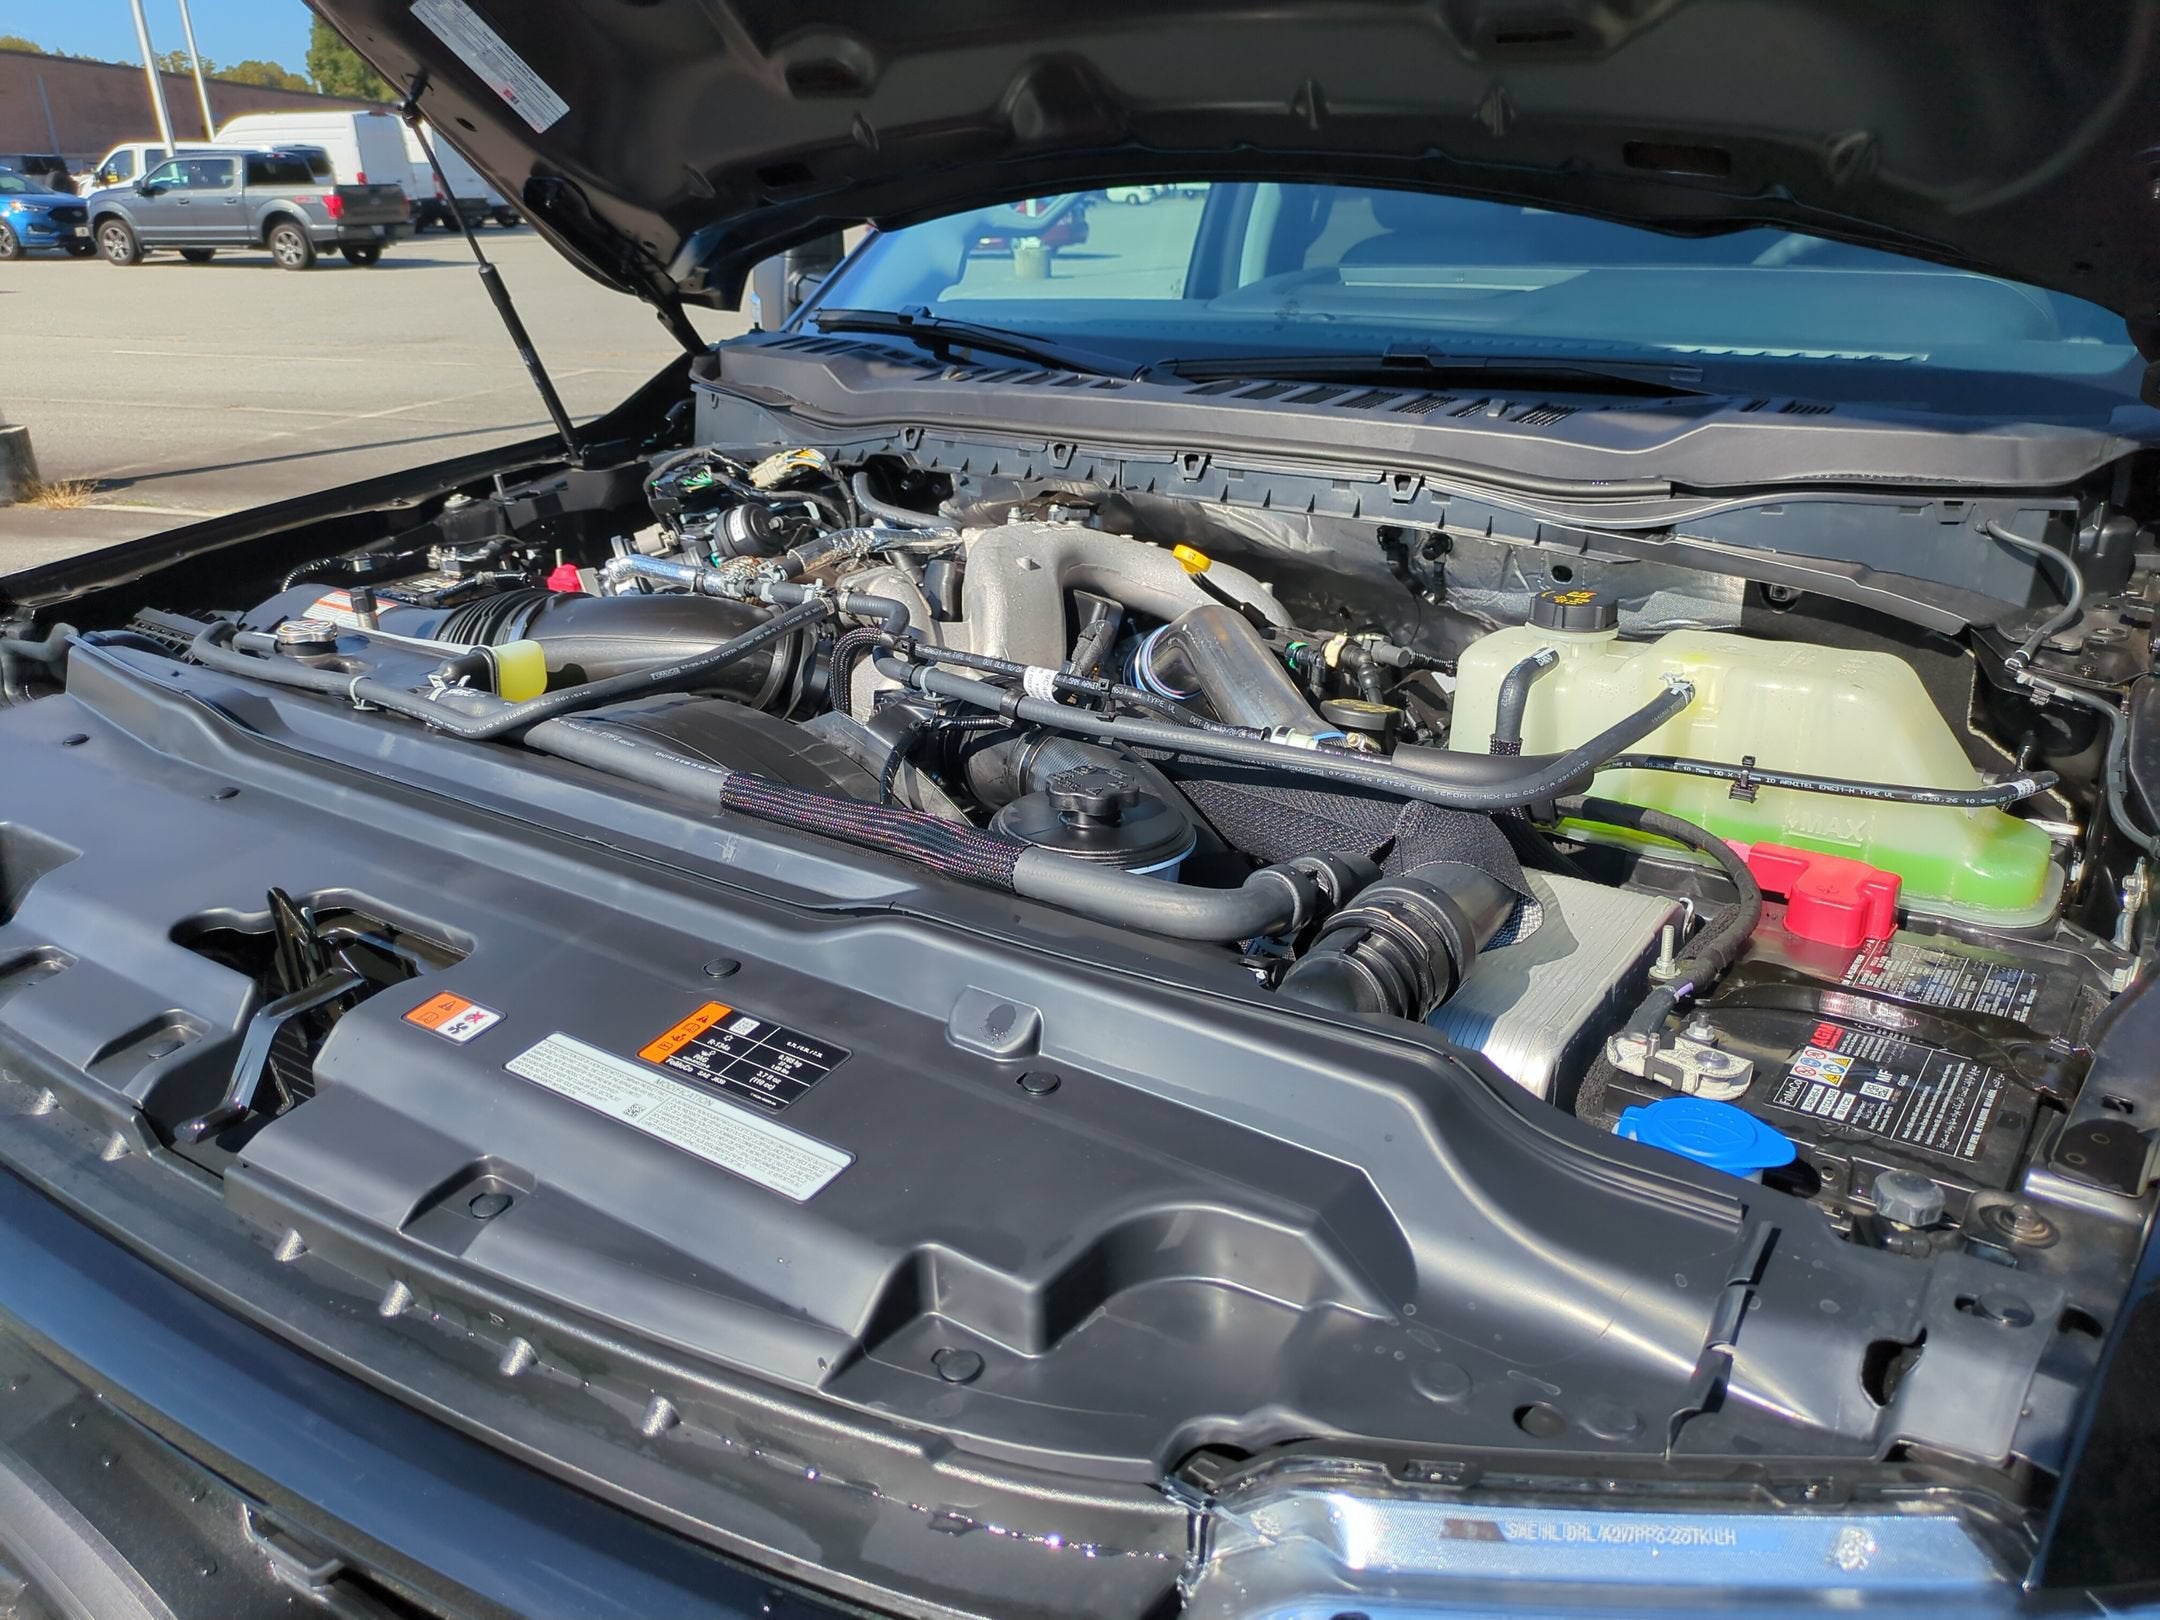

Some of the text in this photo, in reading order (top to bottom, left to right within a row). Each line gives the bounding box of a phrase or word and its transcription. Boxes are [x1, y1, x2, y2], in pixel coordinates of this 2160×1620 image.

[1146, 694, 1165, 709] TYPE
[1779, 779, 1815, 789] ARNITEL
[1859, 788, 1880, 797] TYPE
[1798, 811, 1867, 842] MAX
[707, 1038, 731, 1052] R-134a
[692, 1053, 710, 1063] PAG
[665, 1057, 694, 1073] FoMoCo
[696, 1070, 711, 1080] SAE
[756, 1070, 767, 1078] 3.7
[1875, 1068, 1894, 1083] MF
[653, 1077, 715, 1106] MODIFICATION
[1778, 1079, 1803, 1106] FoMoCo
